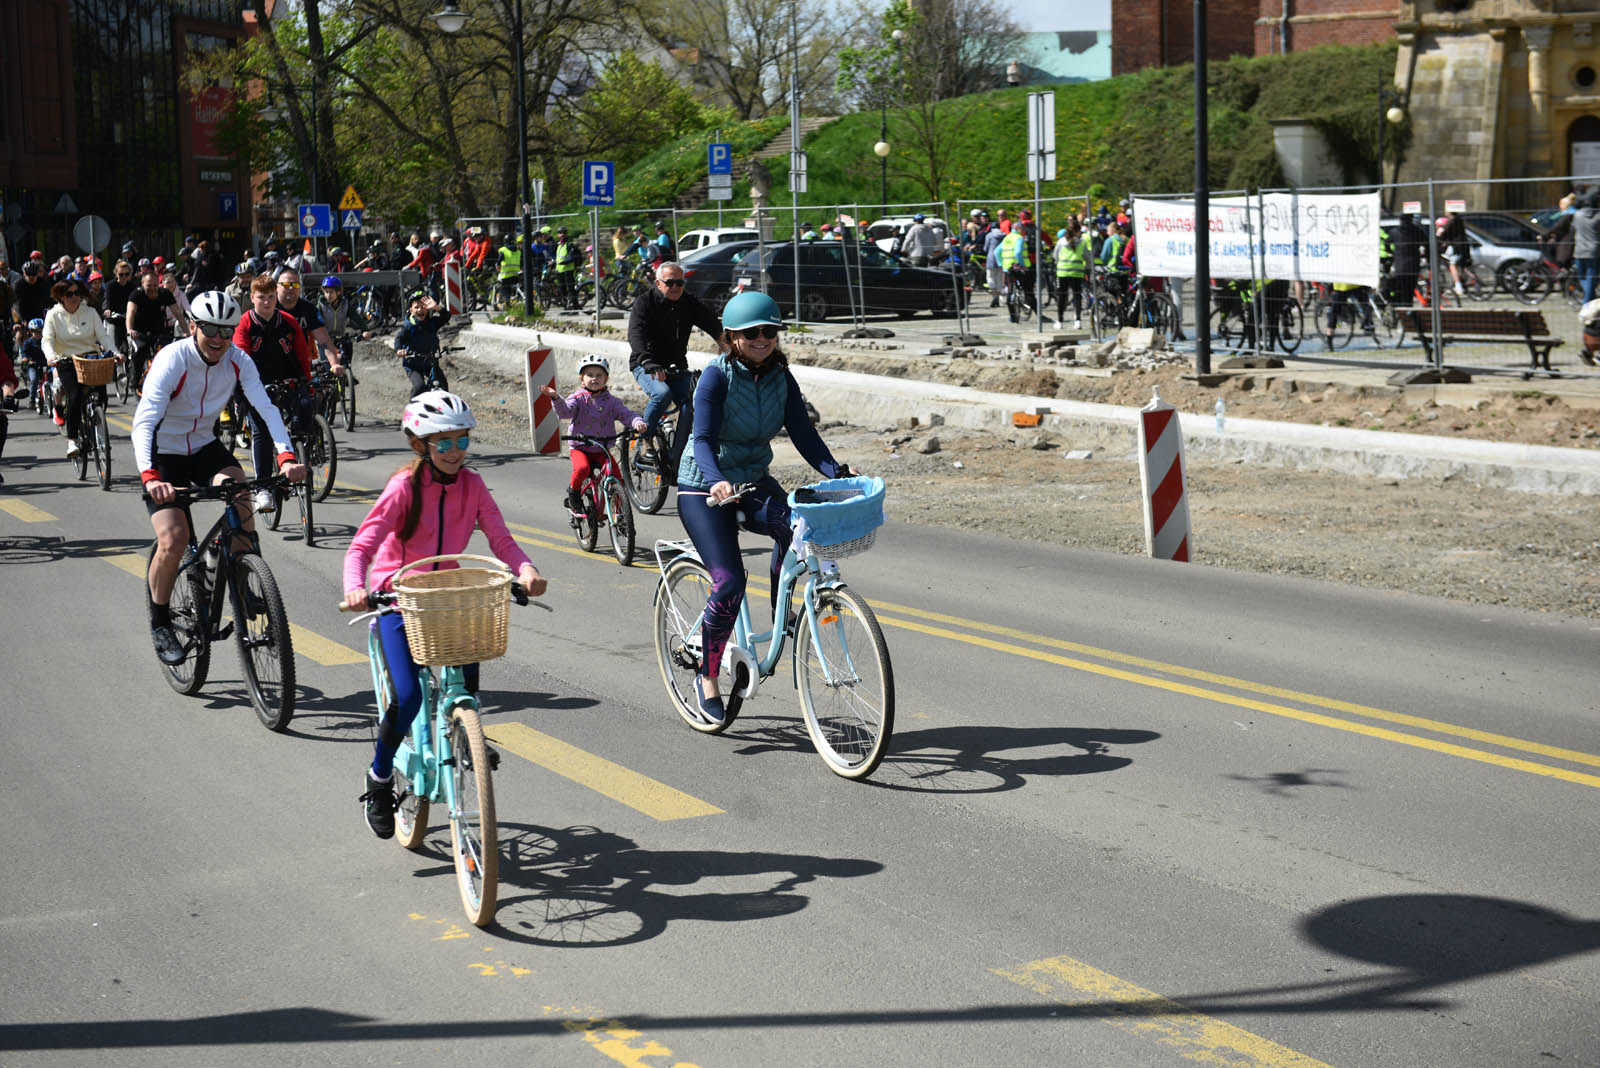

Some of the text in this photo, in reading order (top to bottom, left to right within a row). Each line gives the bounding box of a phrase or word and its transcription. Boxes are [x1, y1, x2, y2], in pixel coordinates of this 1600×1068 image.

[713, 146, 726, 165] P
[591, 165, 608, 192] P
[224, 198, 232, 212] P
